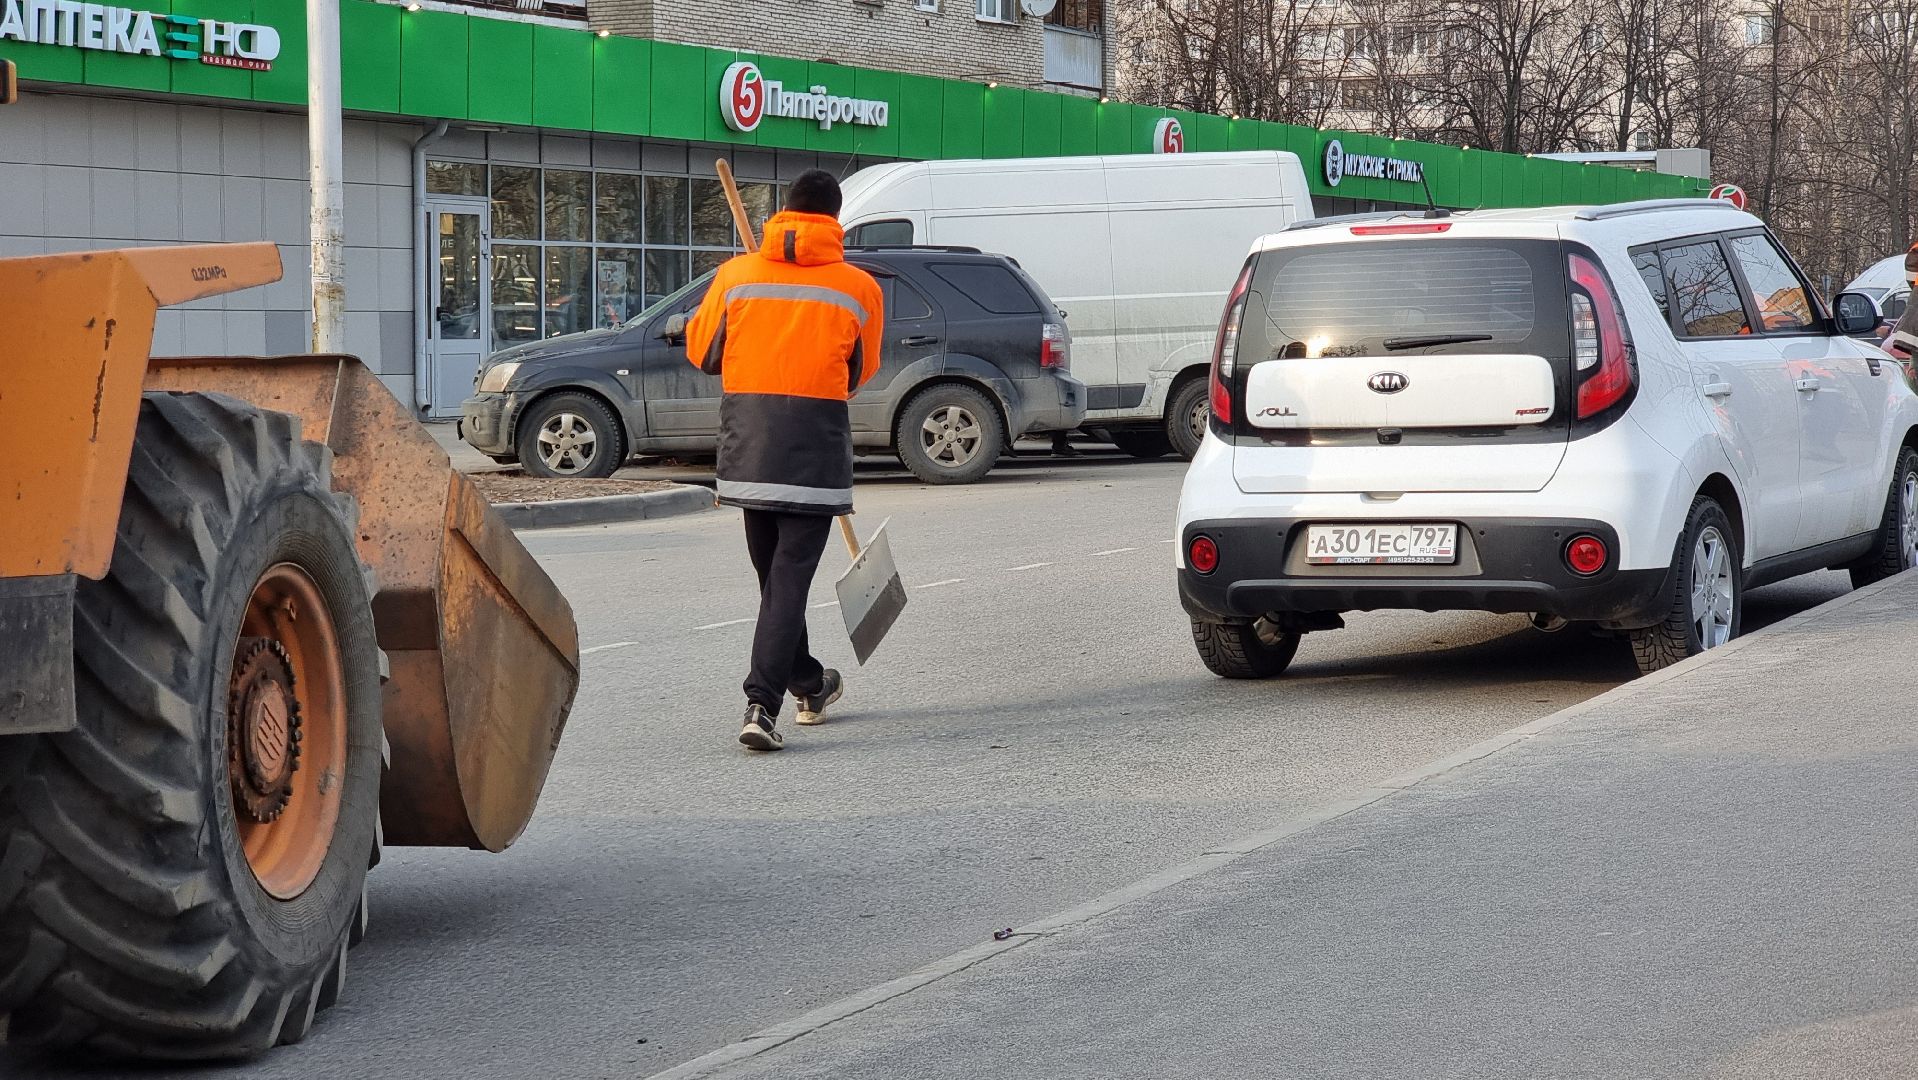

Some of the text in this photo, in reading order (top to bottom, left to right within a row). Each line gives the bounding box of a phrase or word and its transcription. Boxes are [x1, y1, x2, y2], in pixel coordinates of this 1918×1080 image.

[0, 0, 161, 57] АПТЕКА
[739, 69, 758, 118] 5
[765, 80, 888, 130] Пятёрочка
[1344, 153, 1386, 178] МУЖСКИЕ
[1371, 375, 1402, 389] KIA
[1255, 406, 1298, 417] SOUL
[1412, 527, 1450, 547] 797
